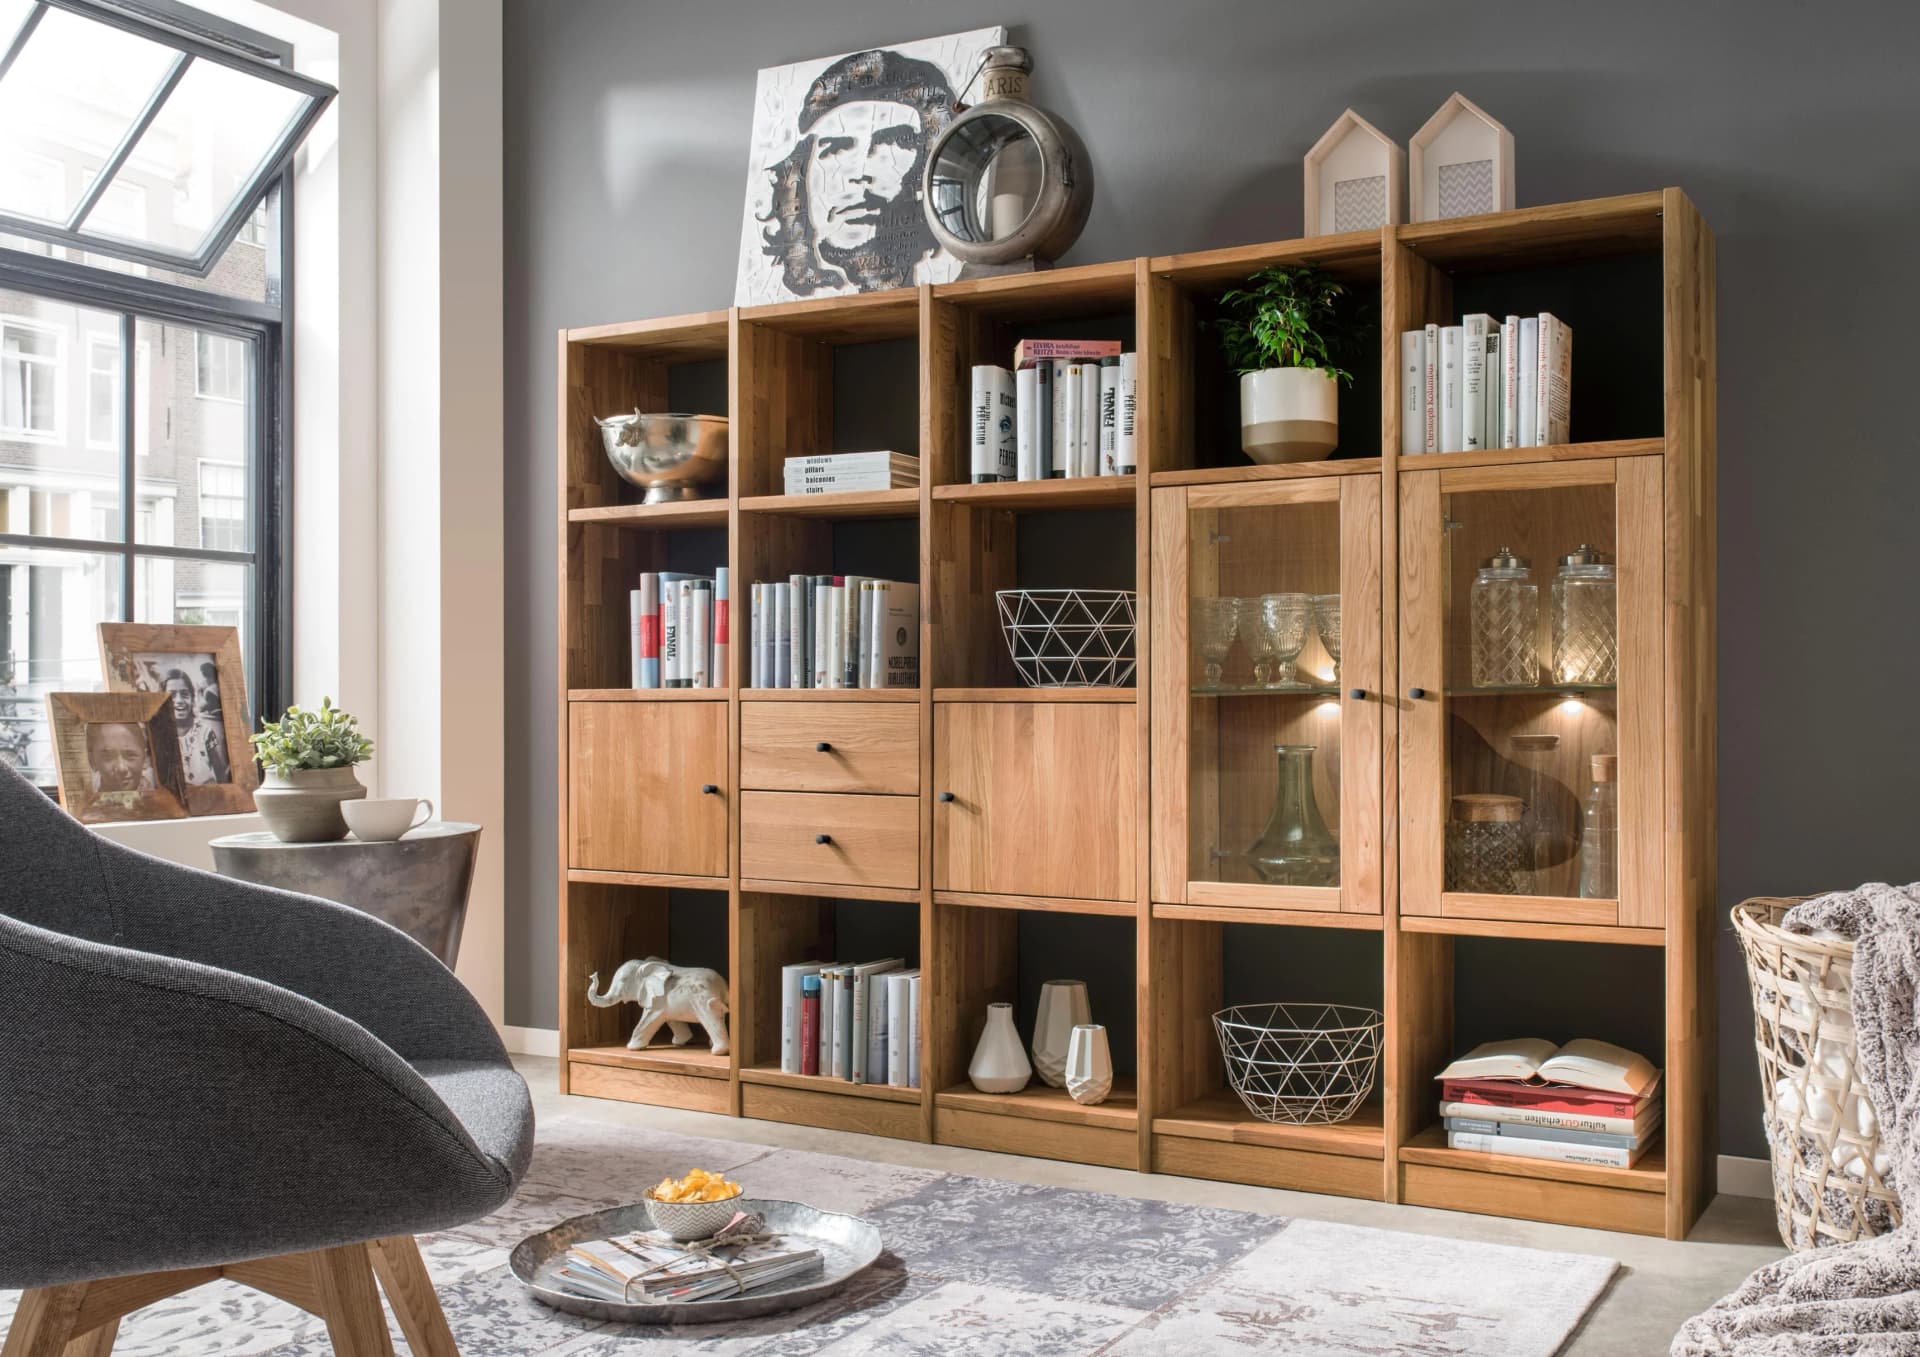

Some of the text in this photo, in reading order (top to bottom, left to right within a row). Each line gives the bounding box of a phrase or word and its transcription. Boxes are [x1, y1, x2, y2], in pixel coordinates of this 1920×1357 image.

[1104, 387, 1116, 428] FANAL
[805, 466, 824, 474] pillars
[806, 476, 835, 484] balconies
[666, 625, 676, 661] FANAL
[1525, 1115, 1606, 1131] kulturGUTerhalten
